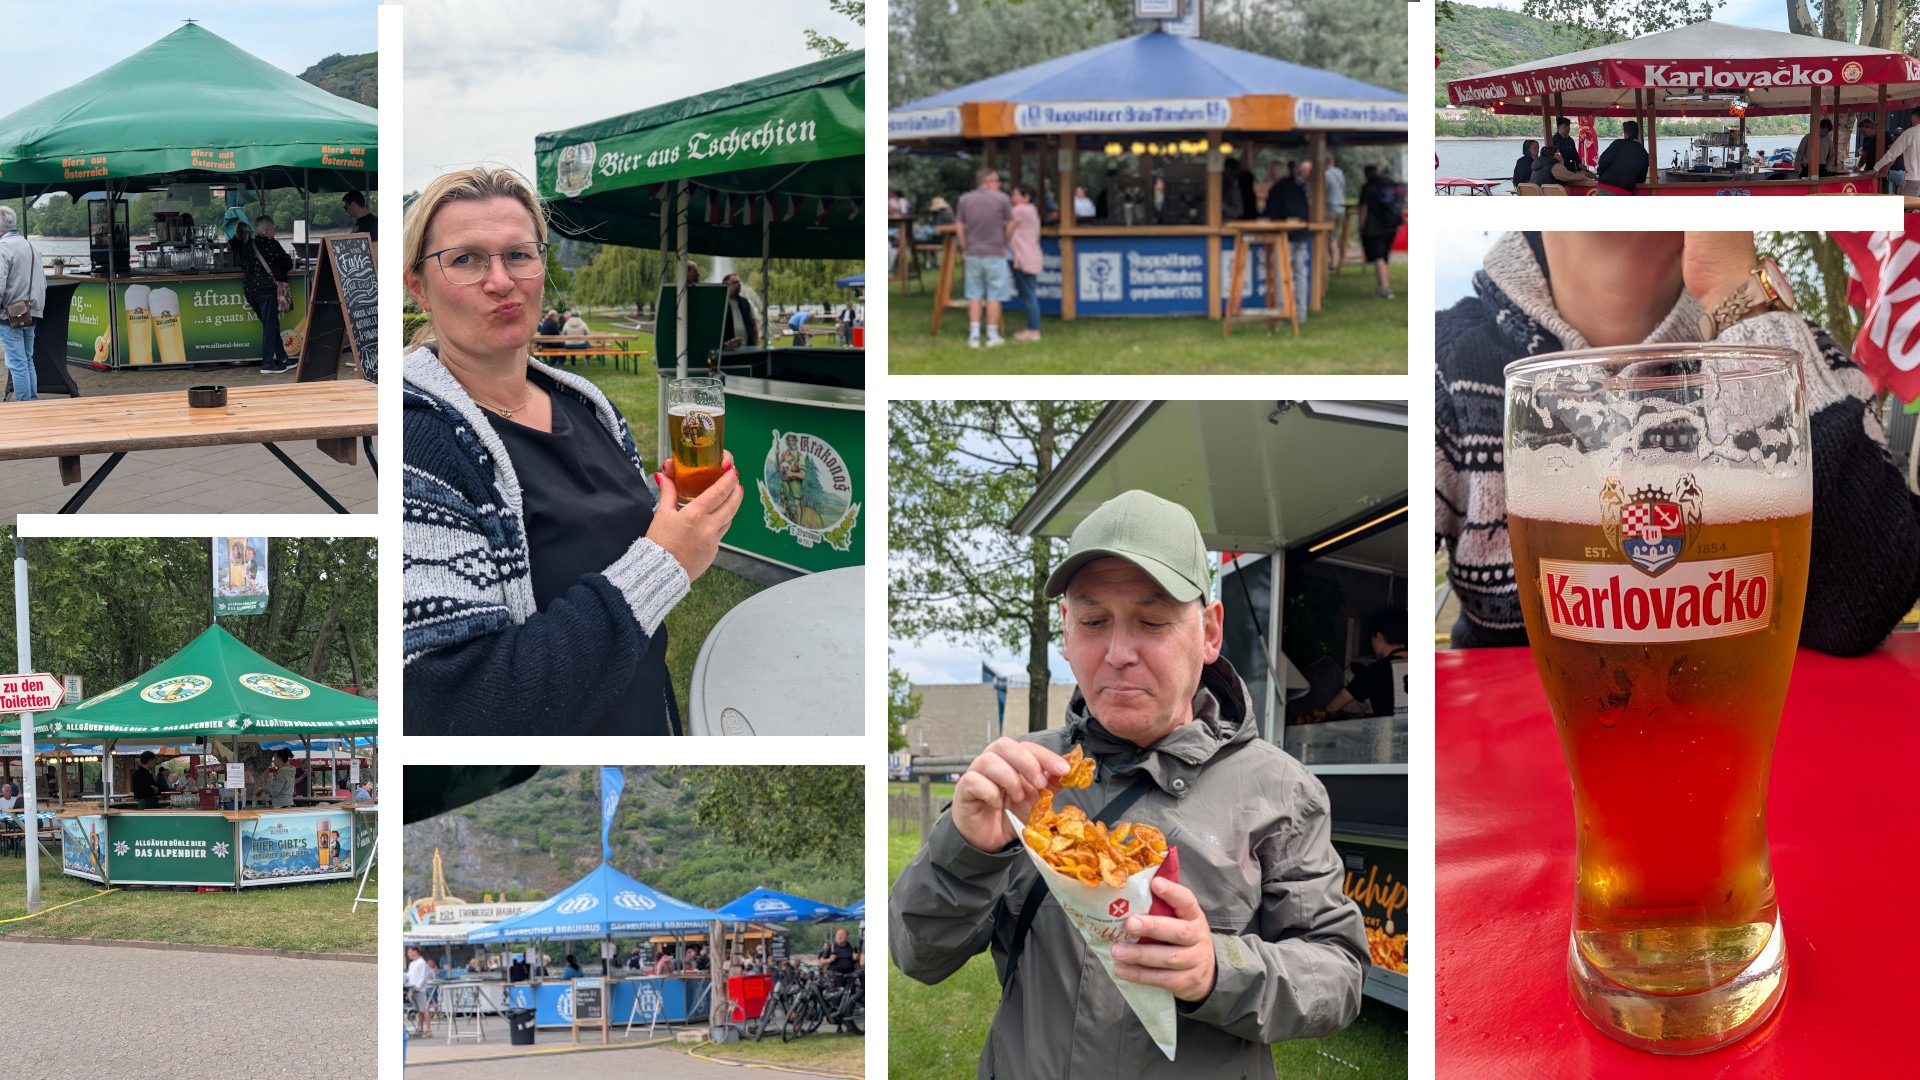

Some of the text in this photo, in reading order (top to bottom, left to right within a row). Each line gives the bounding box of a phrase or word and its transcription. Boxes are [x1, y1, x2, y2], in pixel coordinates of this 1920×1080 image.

[1644, 63, 1834, 88] Karlovačko
[1454, 82, 1508, 103] Karlovačko
[1532, 76, 1545, 94] in
[1547, 71, 1591, 93] Croatia
[191, 149, 214, 157] Biere
[321, 145, 366, 155] Biere aus
[598, 118, 817, 177] Bier aus Tschechien
[62, 158, 85, 167] Biere
[191, 157, 235, 169] Österreich
[321, 155, 365, 168] Österreich
[64, 167, 108, 179] Österreich
[214, 313, 244, 326] guats
[1585, 542, 1728, 558] EST. 1854
[1546, 568, 1768, 631] Karlovačko
[3, 679, 44, 693] zu den
[0, 694, 51, 709] Toiletten
[66, 723, 103, 731] ALLGÄUER
[179, 721, 223, 730] ALPENBIER
[135, 839, 168, 847] ALLGÄUER
[169, 839, 190, 847] BÜBLE
[253, 840, 274, 852] HIER
[135, 849, 207, 858] DAS ALPENBIER
